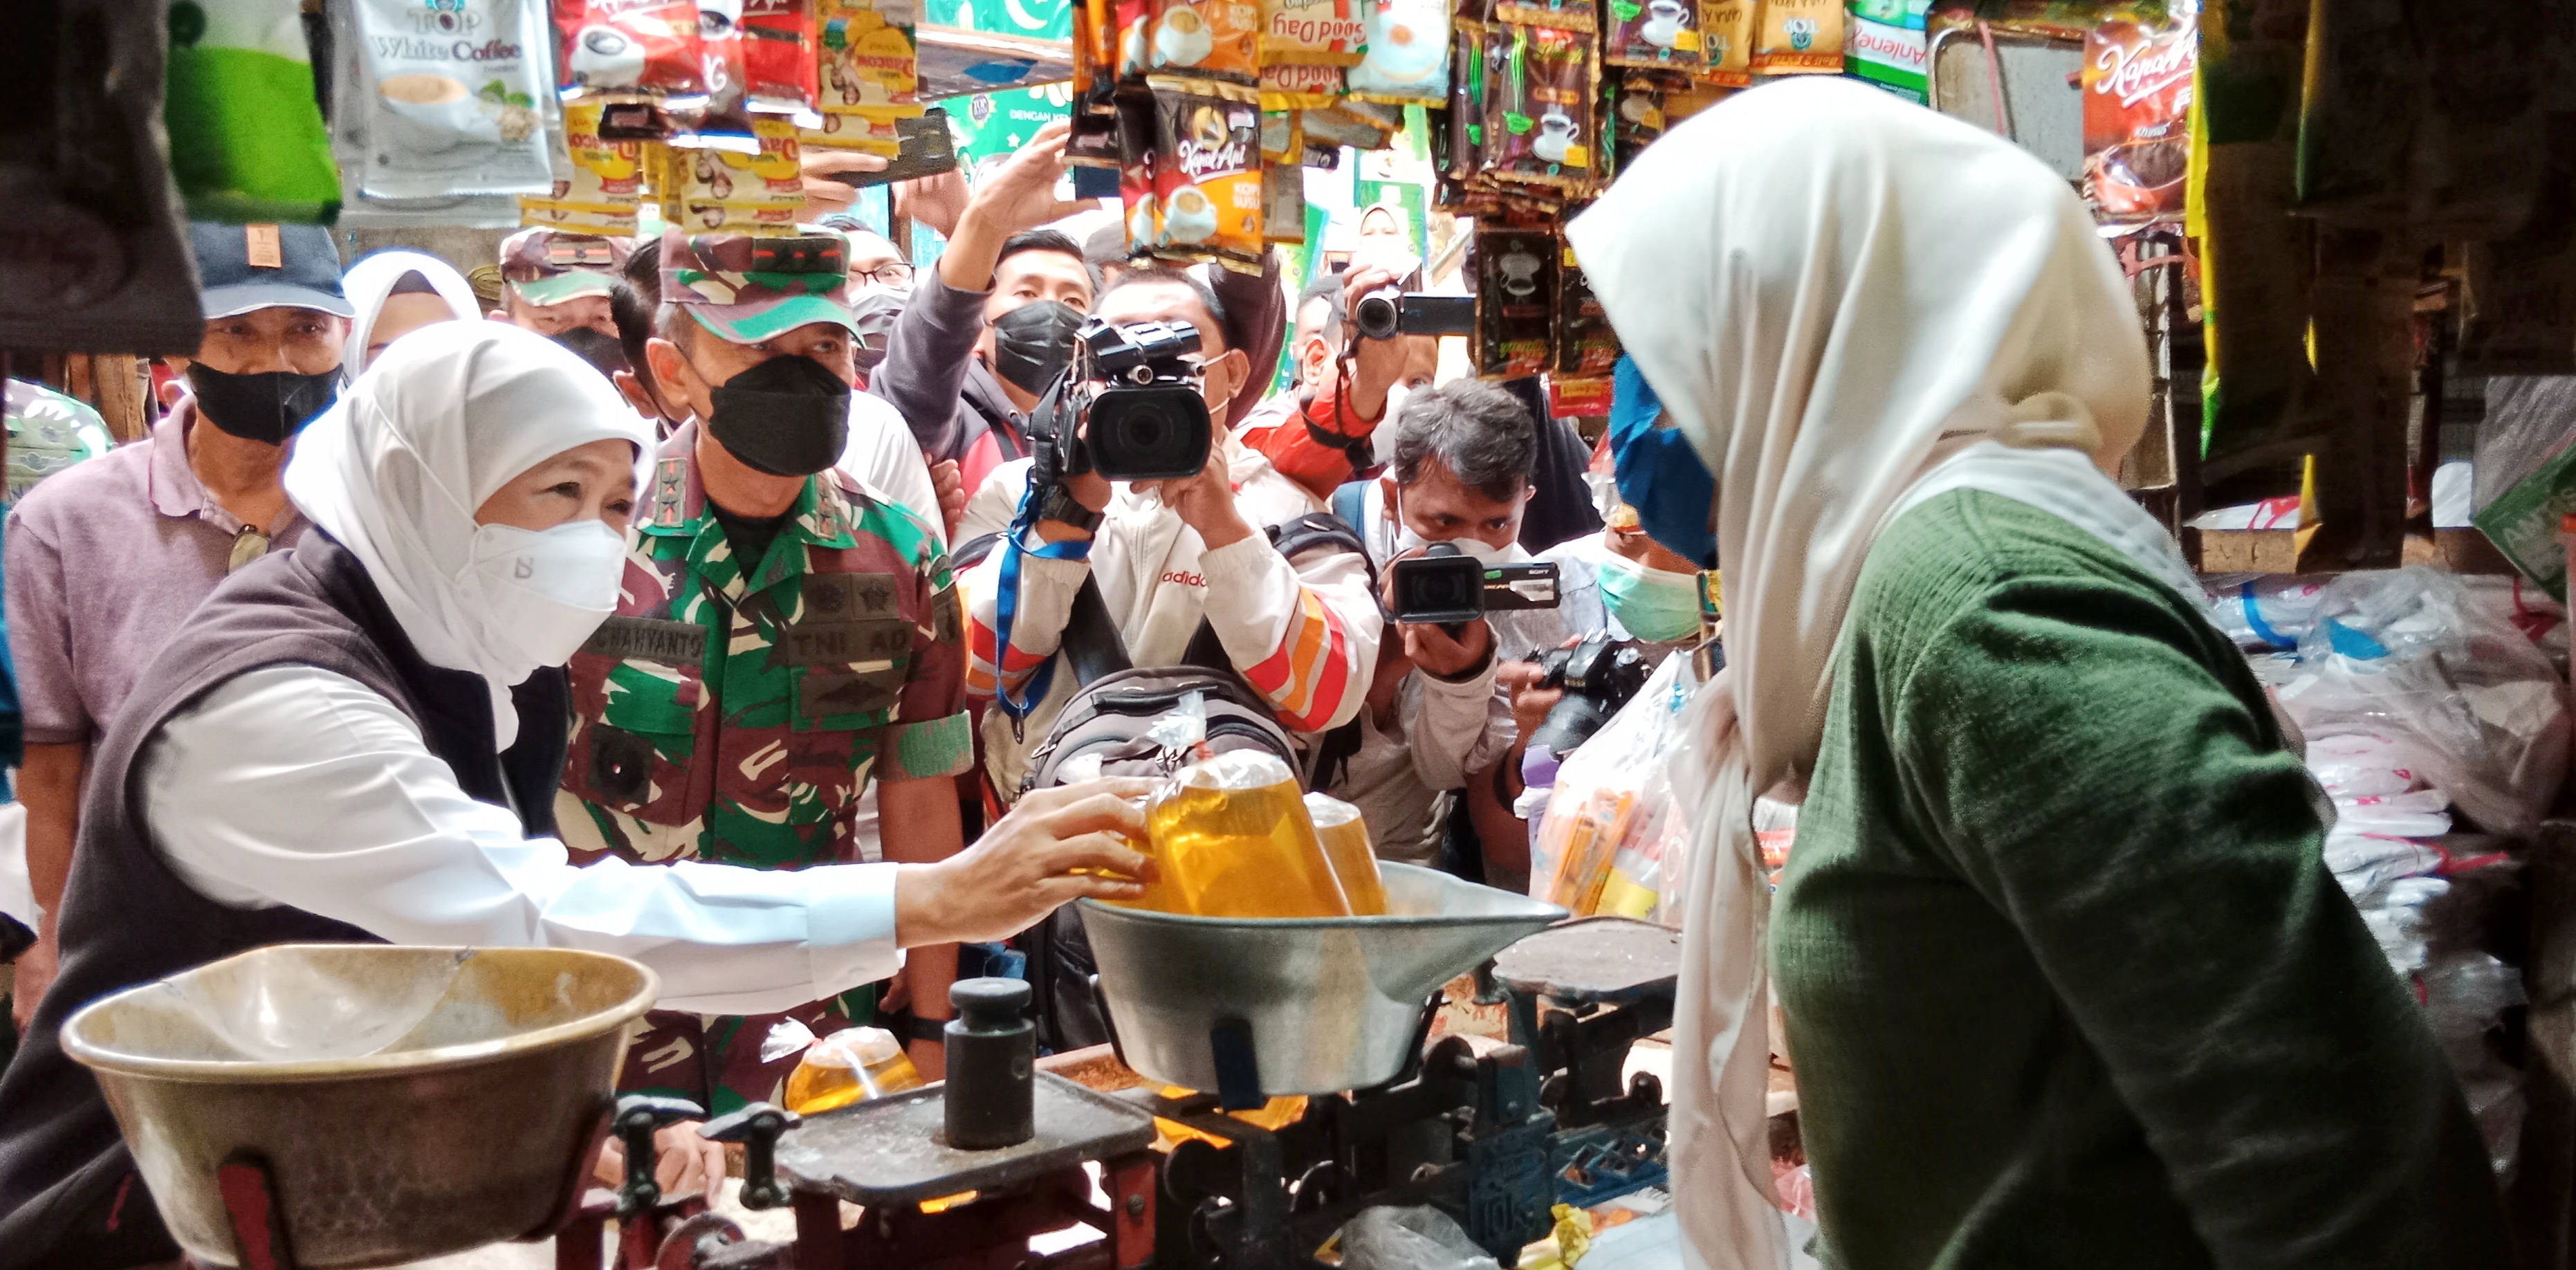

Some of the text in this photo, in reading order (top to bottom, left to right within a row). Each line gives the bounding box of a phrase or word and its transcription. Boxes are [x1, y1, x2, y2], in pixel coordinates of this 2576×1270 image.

[407, 9, 483, 35] TOP
[1273, 12, 1314, 43] Day
[1783, 19, 1821, 35] TOP
[371, 35, 523, 62] White Coffee
[1705, 34, 1732, 51] TO
[1260, 65, 1293, 89] Da
[1009, 109, 1051, 122] DENGAN
[1162, 570, 1207, 587] adida
[793, 630, 847, 656] TNI
